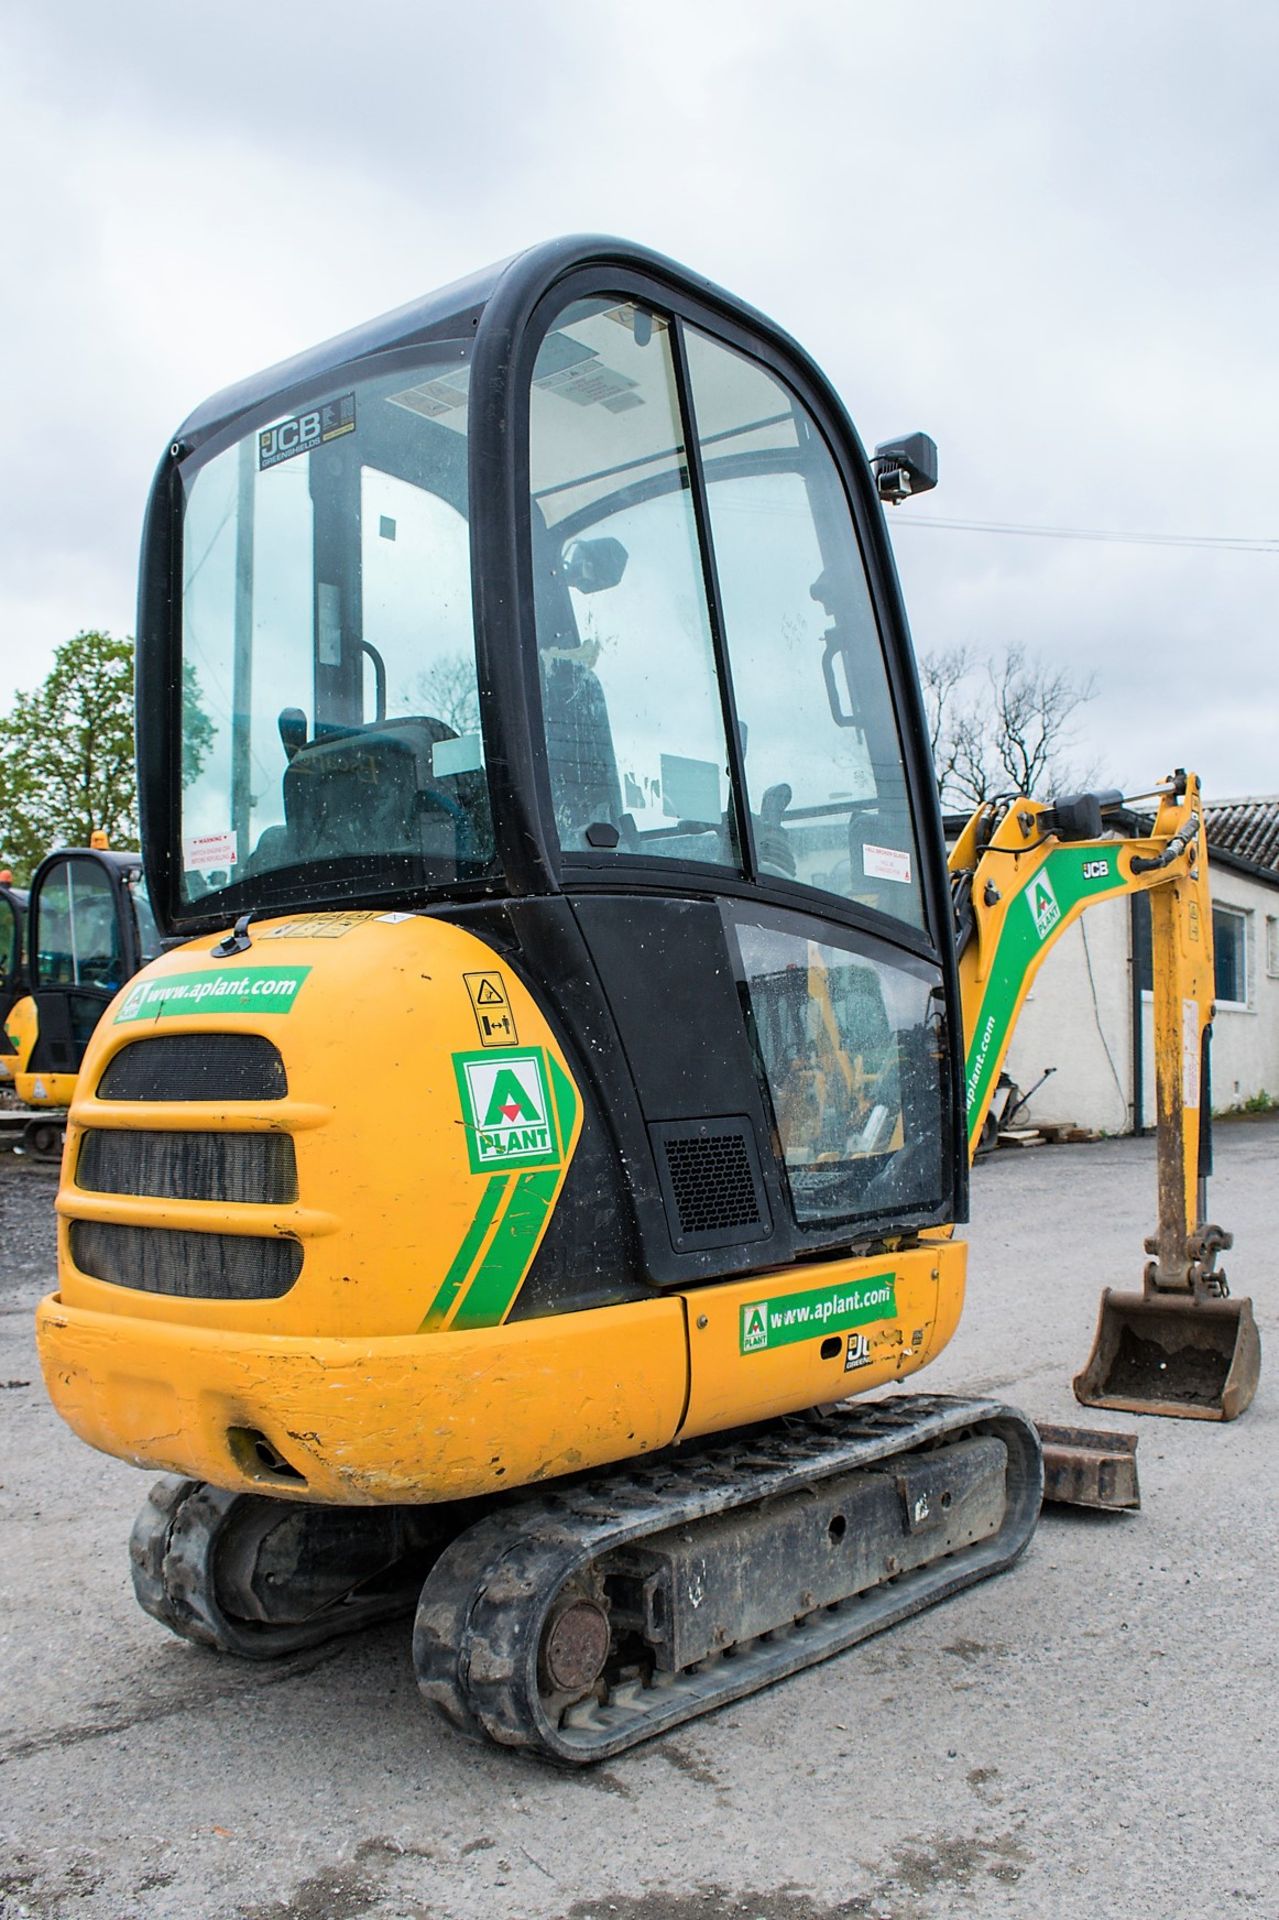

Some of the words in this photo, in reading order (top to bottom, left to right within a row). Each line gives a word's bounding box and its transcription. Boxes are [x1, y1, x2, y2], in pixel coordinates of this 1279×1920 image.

[261, 411, 320, 458] JCB
[262, 437, 320, 467] GREENSHIELDS
[1083, 860, 1109, 878] JCB
[147, 977, 297, 1003] www.aplant.com
[484, 1069, 541, 1126] A
[480, 1128, 548, 1155] PLANT
[770, 1286, 891, 1329] www.aplant.com
[744, 1334, 767, 1348] PLANT
